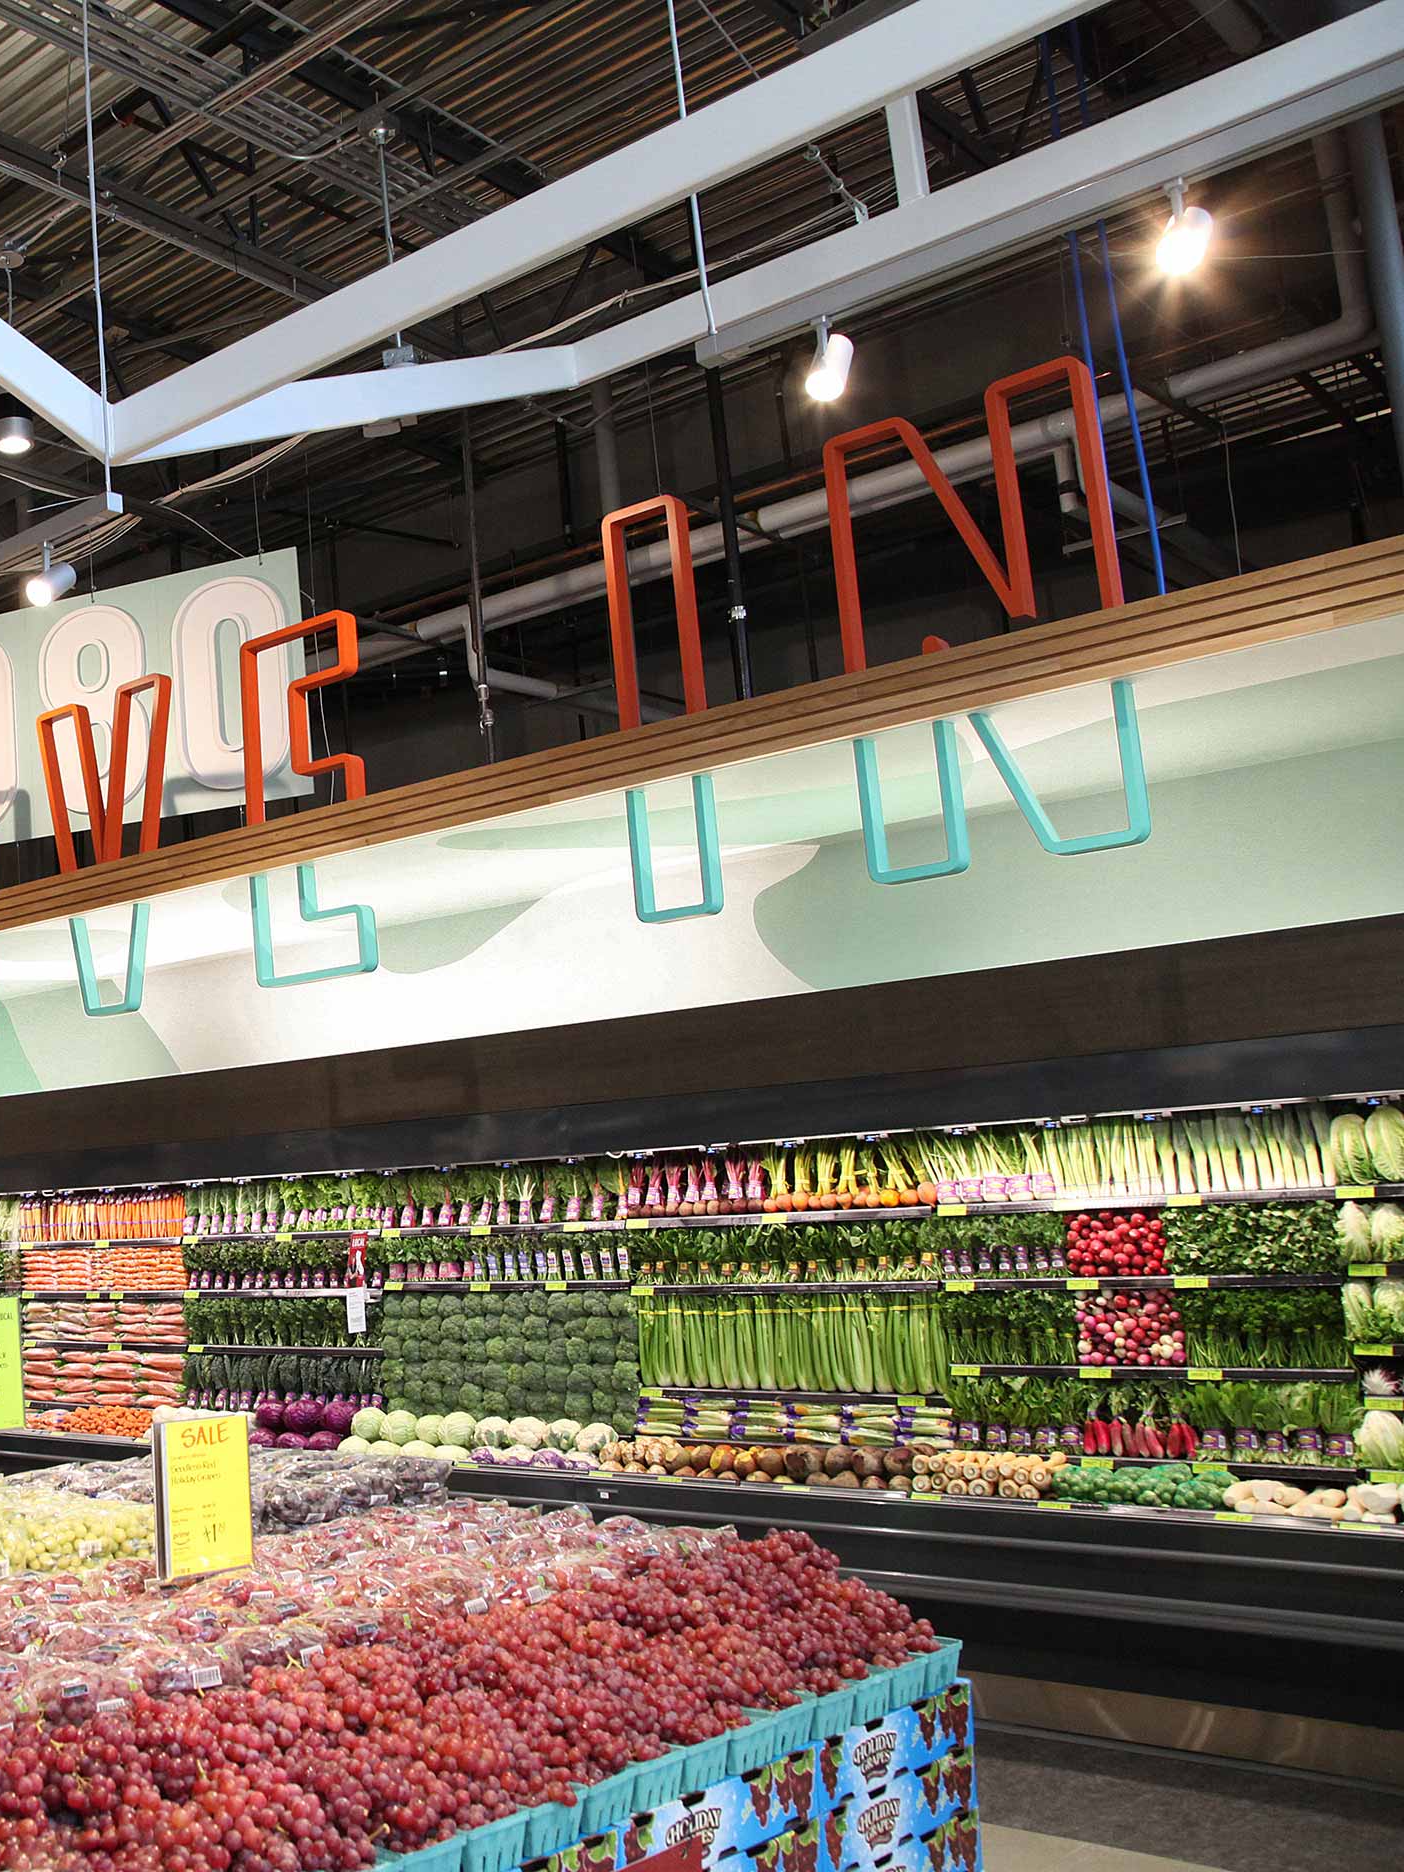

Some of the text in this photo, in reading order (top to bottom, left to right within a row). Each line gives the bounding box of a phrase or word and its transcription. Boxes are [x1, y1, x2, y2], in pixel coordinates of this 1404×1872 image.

[601, 355, 1151, 923] IN
[181, 1421, 230, 1449] SALE
[853, 1732, 897, 1766] HOLIDAY
[861, 1750, 892, 1775] GRAPES
[665, 1808, 722, 1847] HOLIDAY
[857, 1798, 901, 1834] HOLIDAY
[865, 1817, 896, 1843] GRAPES
